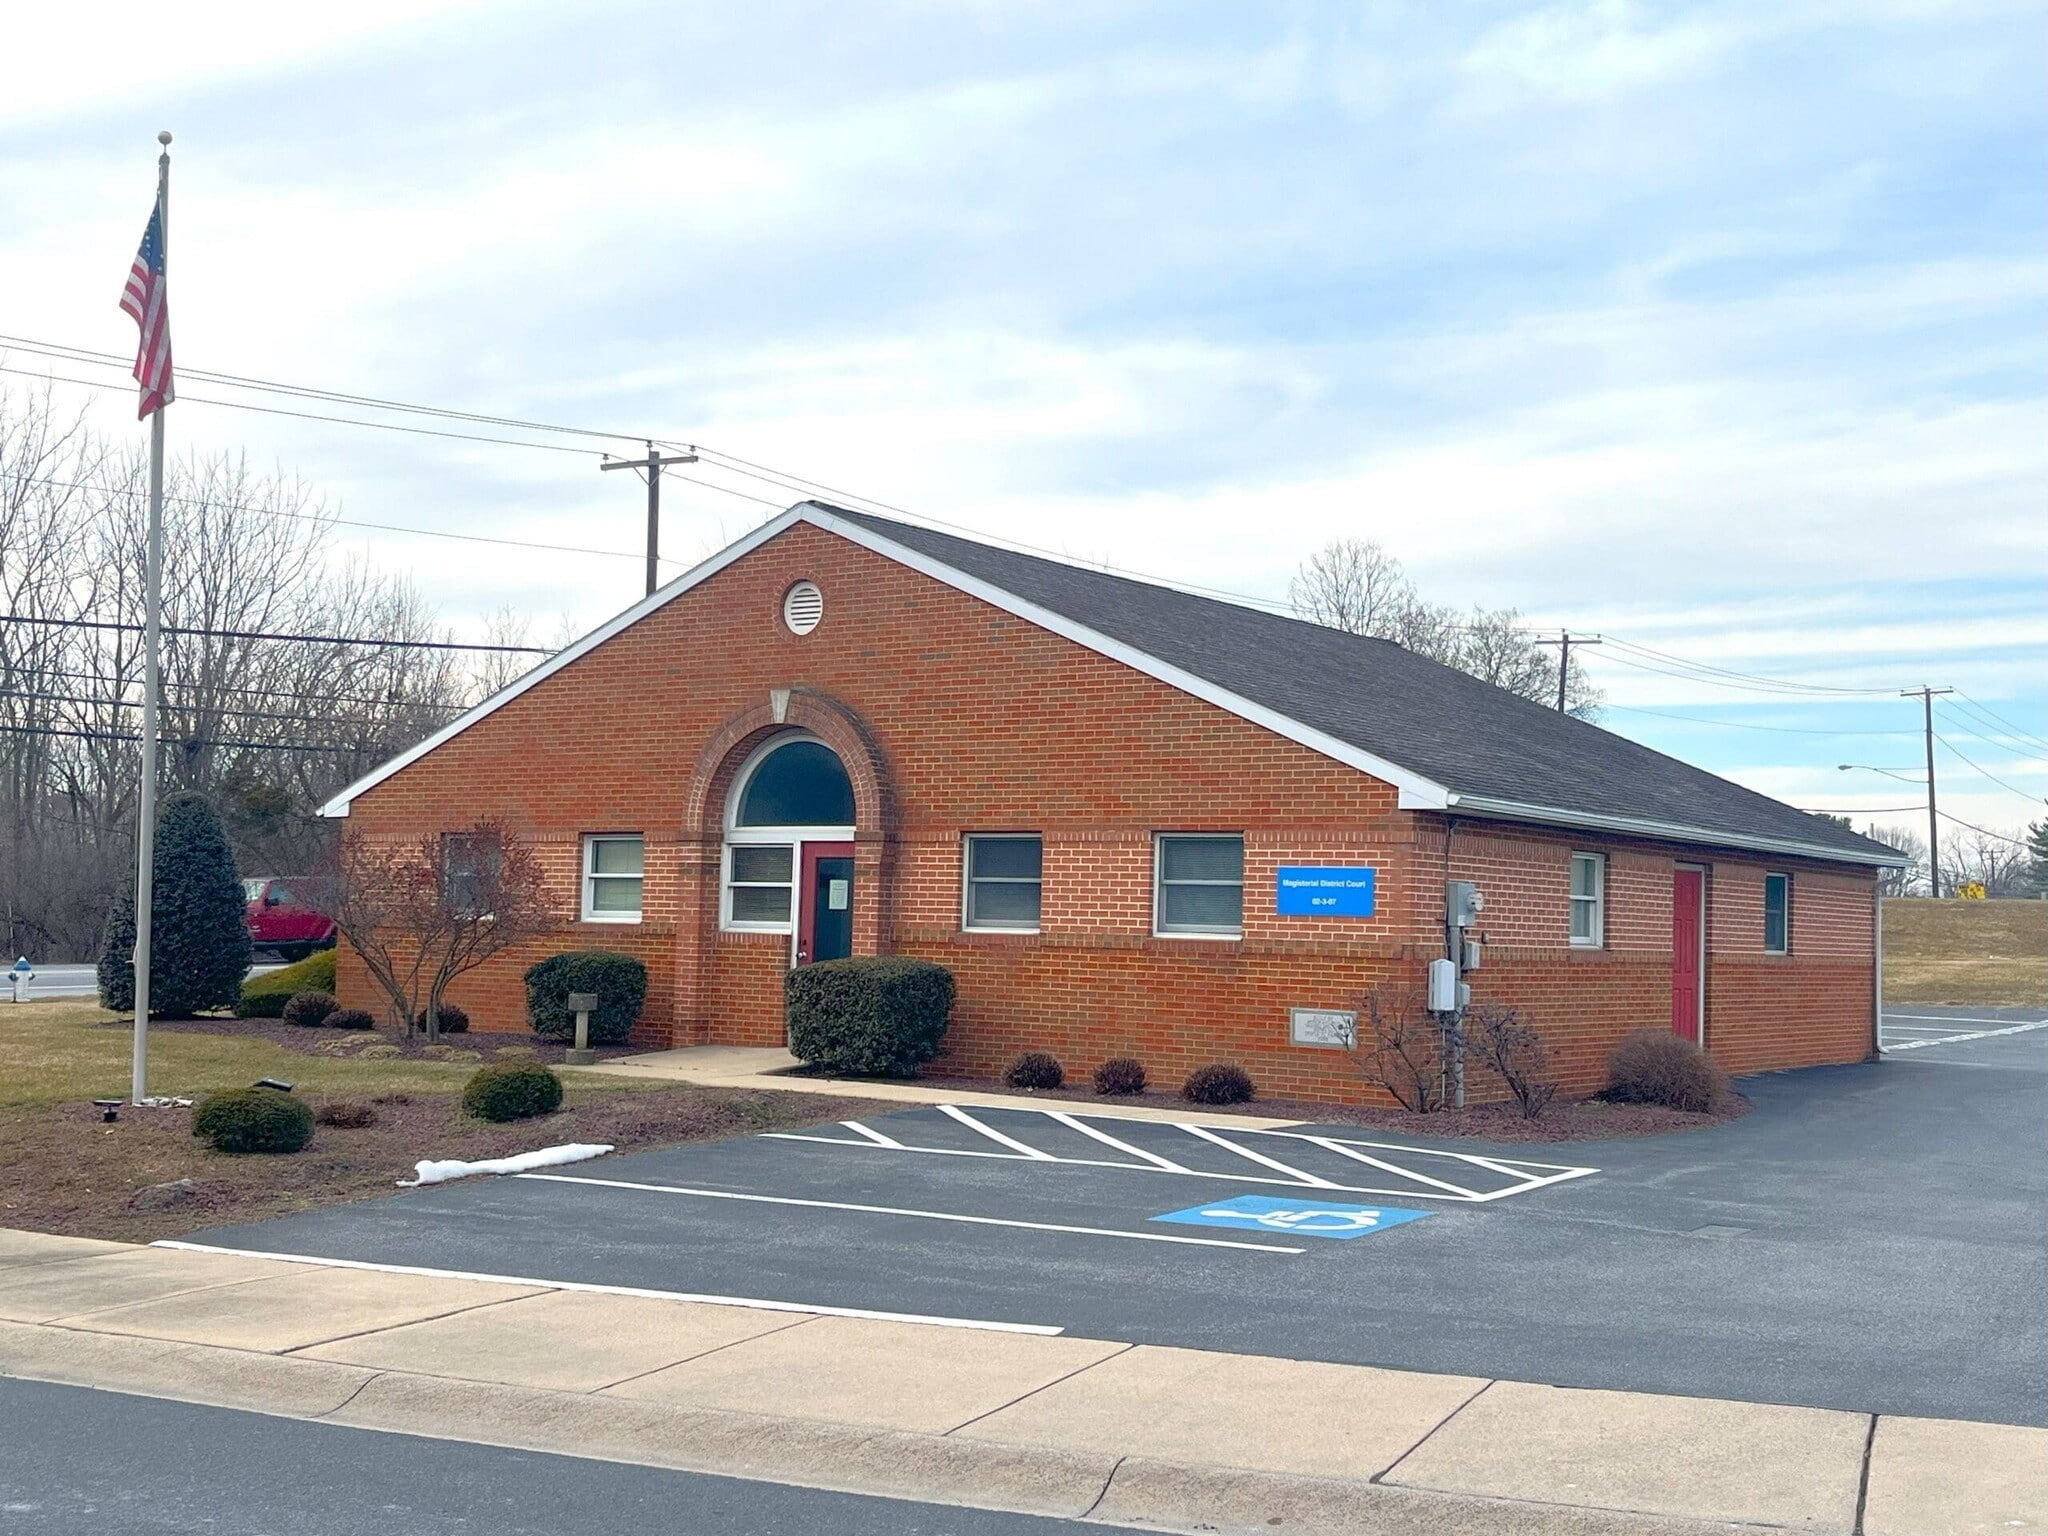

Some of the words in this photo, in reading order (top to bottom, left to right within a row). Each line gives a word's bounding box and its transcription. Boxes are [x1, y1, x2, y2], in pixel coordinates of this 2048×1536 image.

[1282, 879, 1319, 888] Magisterial
[1320, 879, 1345, 888] District
[1346, 880, 1366, 888] Court
